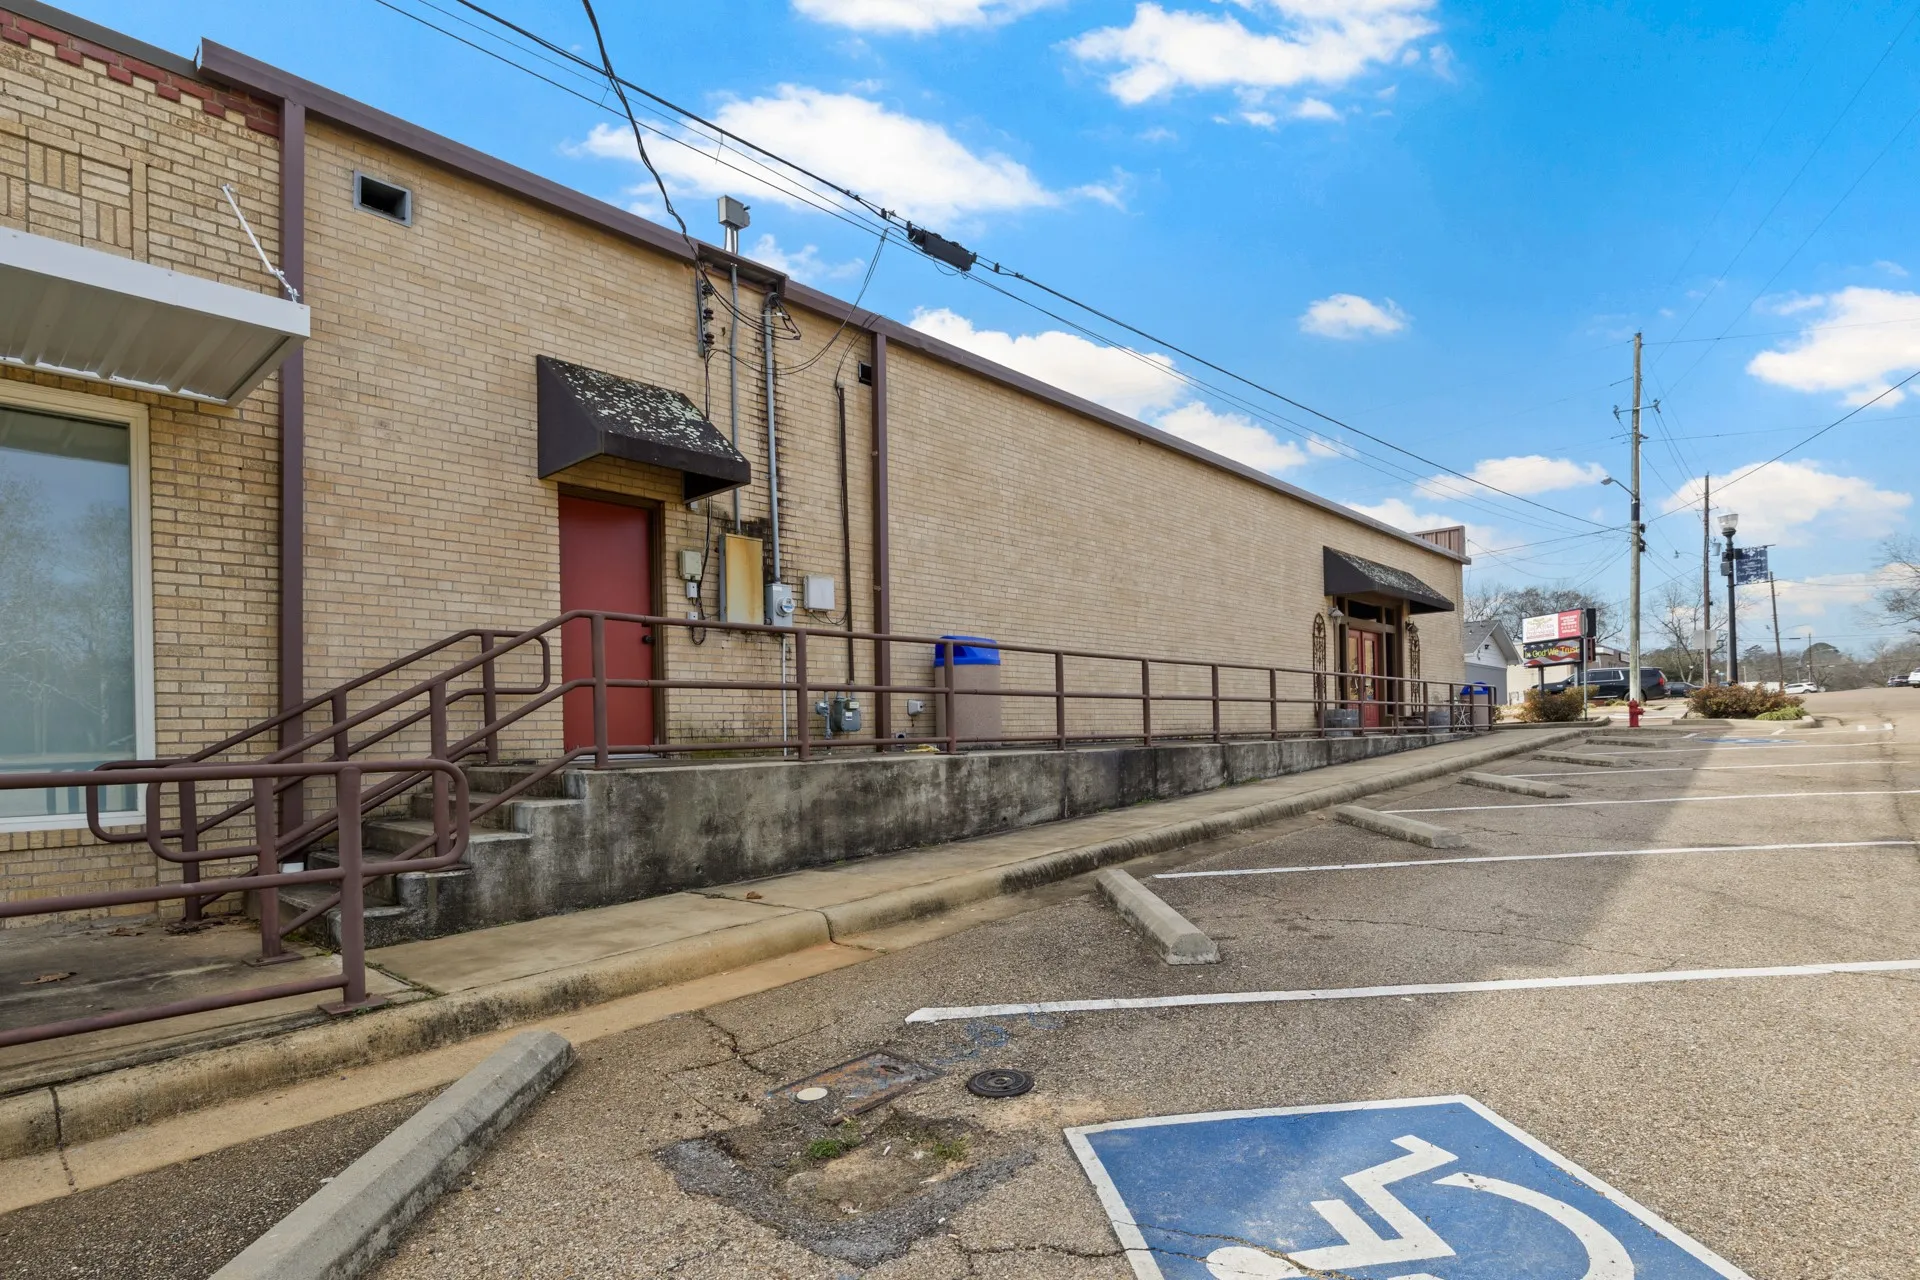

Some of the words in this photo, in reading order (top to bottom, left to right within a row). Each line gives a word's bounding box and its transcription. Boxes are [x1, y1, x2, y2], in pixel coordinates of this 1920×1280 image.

[1532, 649, 1546, 657] God
[1547, 648, 1559, 656] We
[1561, 646, 1579, 654] Trust
